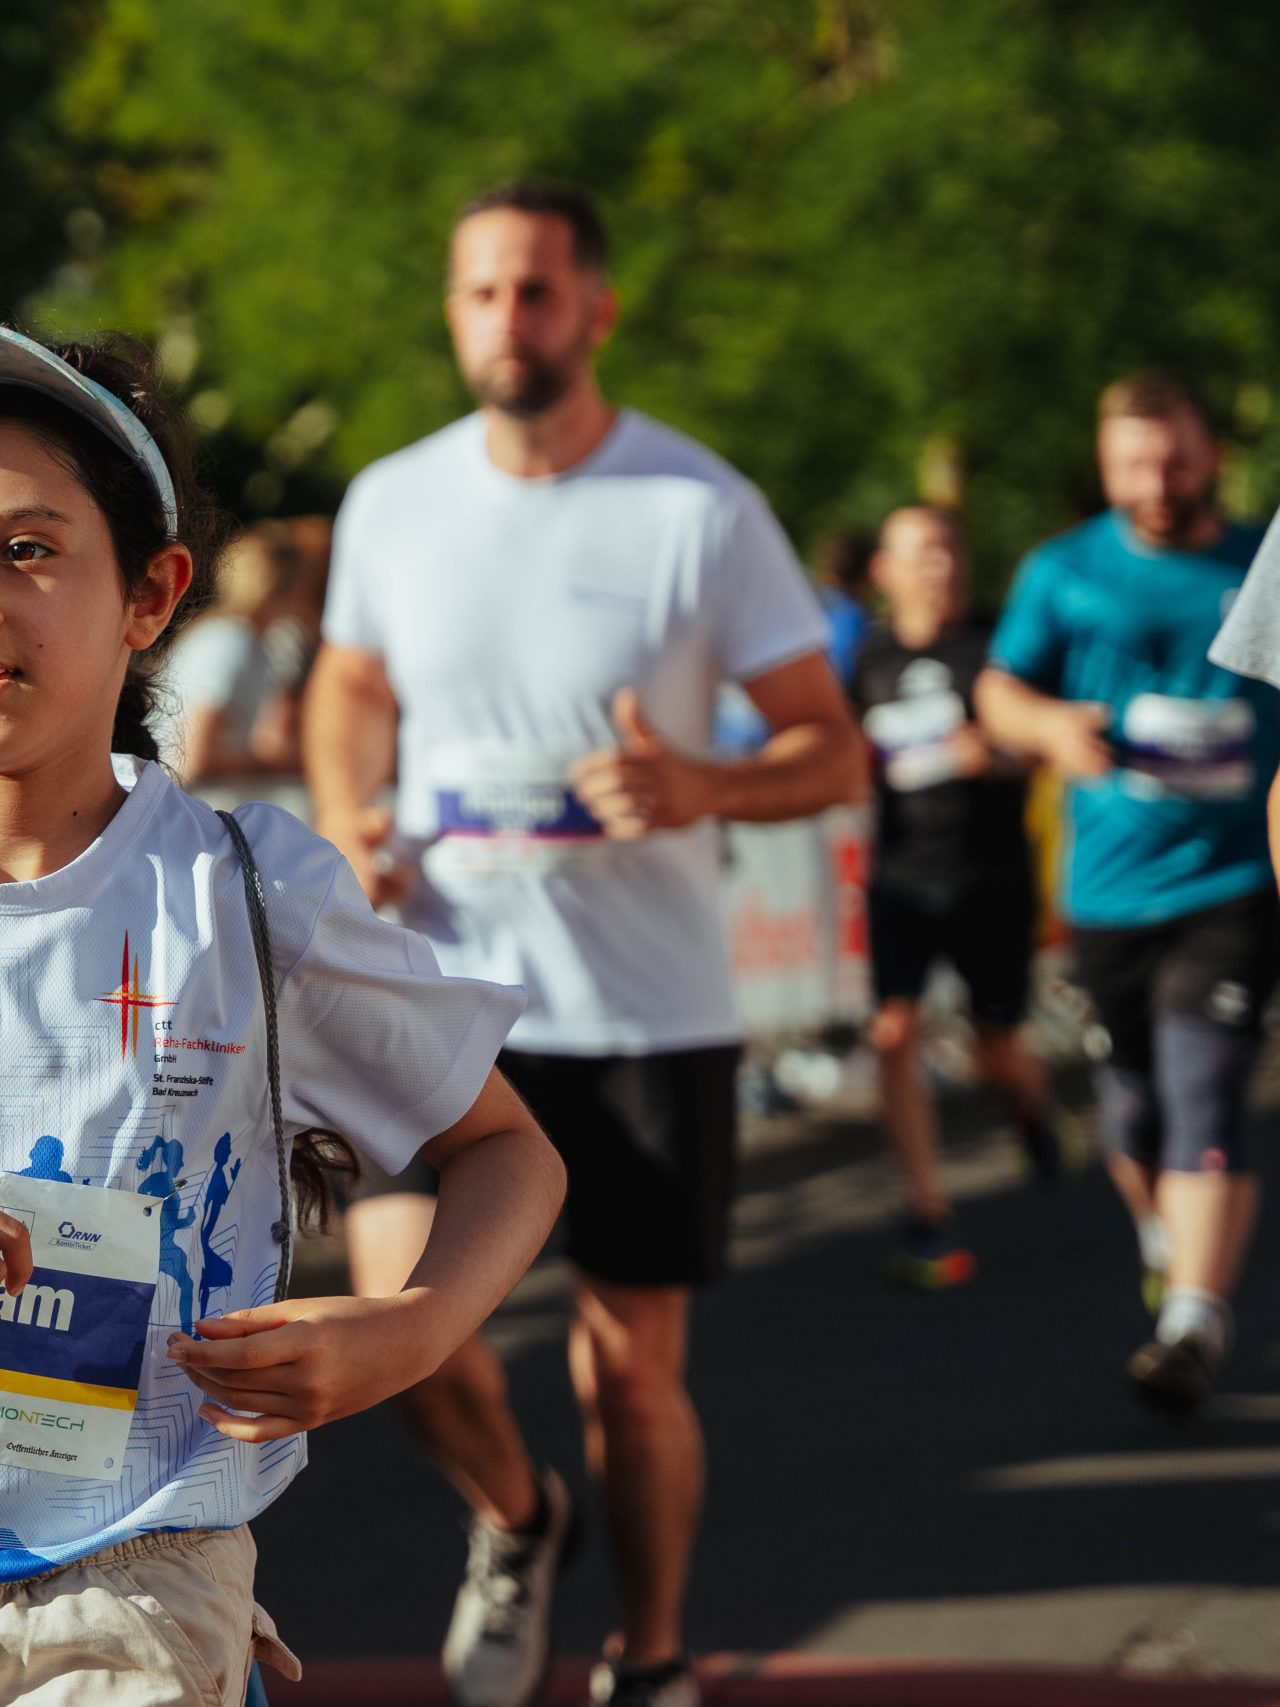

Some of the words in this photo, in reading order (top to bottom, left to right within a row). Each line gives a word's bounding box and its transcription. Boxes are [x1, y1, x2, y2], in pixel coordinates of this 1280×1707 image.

[155, 1020, 173, 1031] ctt
[153, 1036, 246, 1054] Reha-Fachkliniken
[154, 1054, 177, 1063] GmbH
[153, 1073, 165, 1083] St.
[152, 1087, 167, 1096] Bad
[6, 1442, 49, 1457] Oeffentlicher
[49, 1449, 78, 1462] Anzeiger
